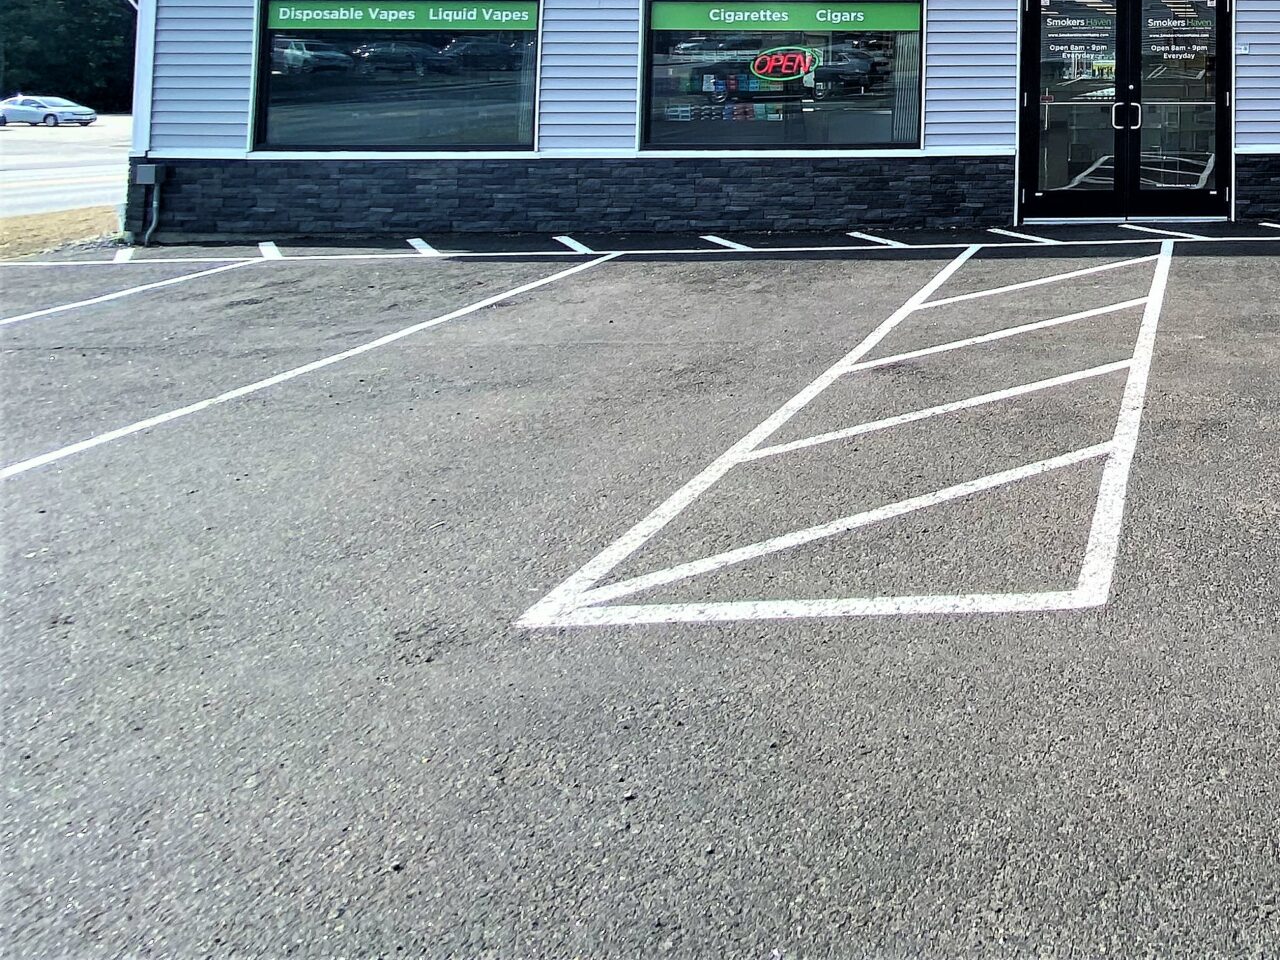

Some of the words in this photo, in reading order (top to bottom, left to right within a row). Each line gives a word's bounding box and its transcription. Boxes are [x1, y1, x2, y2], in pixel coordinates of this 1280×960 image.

[278, 7, 364, 22] Disposable
[368, 7, 416, 22] Vapes
[429, 8, 477, 22] Liquid
[482, 8, 529, 23] Vapes
[708, 9, 790, 24] Cigarettes
[815, 9, 865, 24] Cigars
[1046, 18, 1085, 26] Smokers
[1086, 18, 1112, 26] Haven
[1147, 18, 1186, 27] Smokers
[1186, 19, 1212, 27] Haven
[753, 53, 813, 74] OPEN
